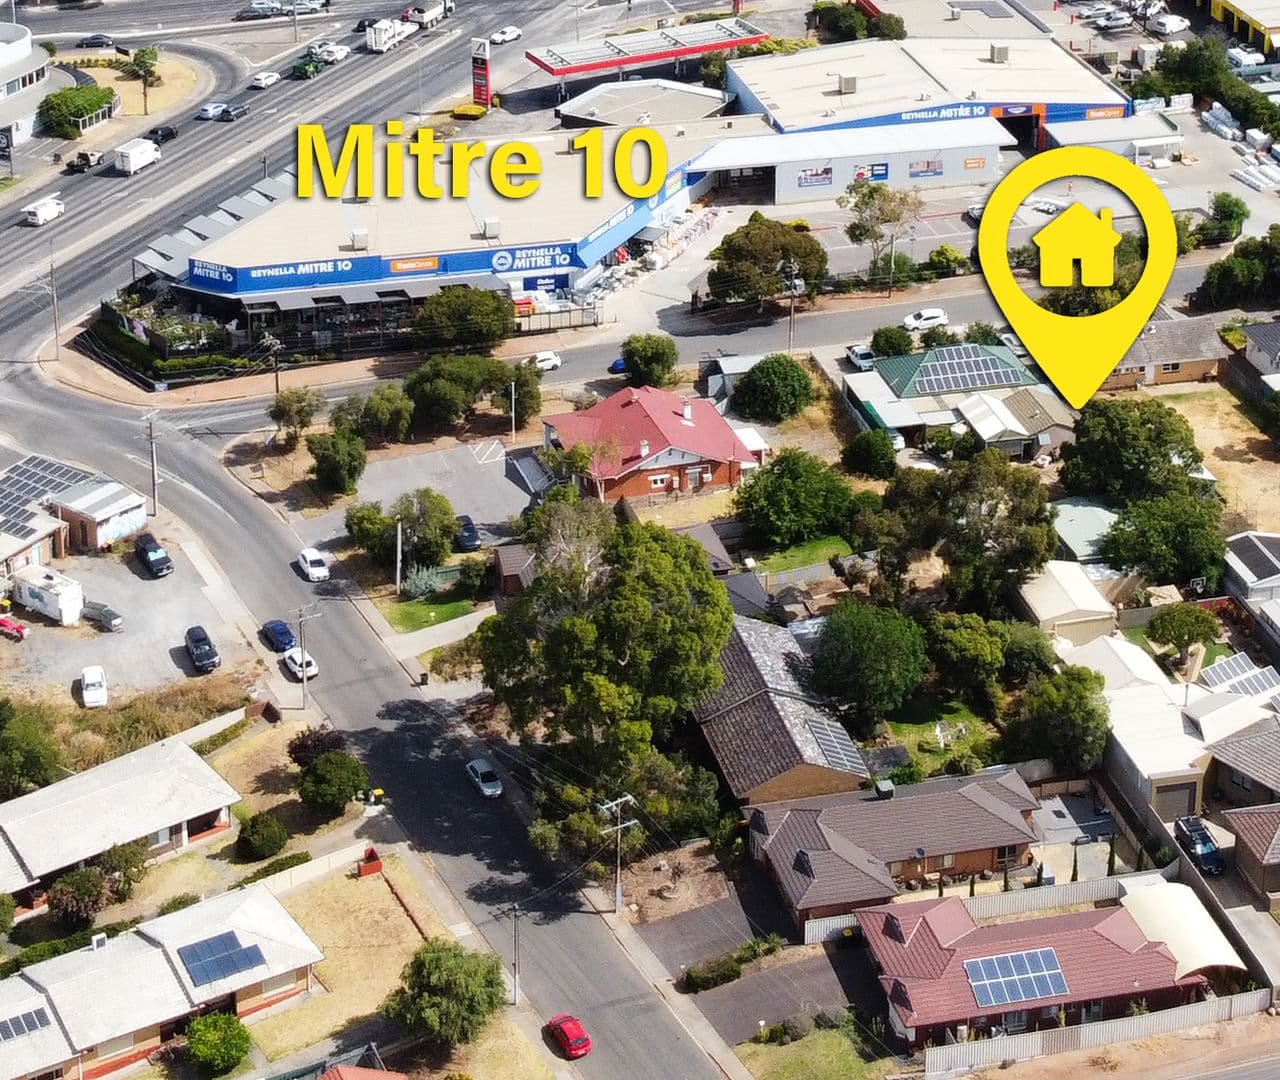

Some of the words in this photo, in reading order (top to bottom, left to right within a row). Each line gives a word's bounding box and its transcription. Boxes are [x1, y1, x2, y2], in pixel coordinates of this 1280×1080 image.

[939, 106, 970, 118] MITRE
[973, 106, 985, 115] 10
[515, 247, 561, 258] REYNELLA
[513, 256, 552, 269] MITRE
[555, 254, 570, 265] 10
[193, 269, 221, 280] MITRE
[220, 273, 233, 282] 10
[251, 266, 295, 278] REYNELLA
[296, 262, 334, 275] MITRE
[336, 260, 352, 271] 10
